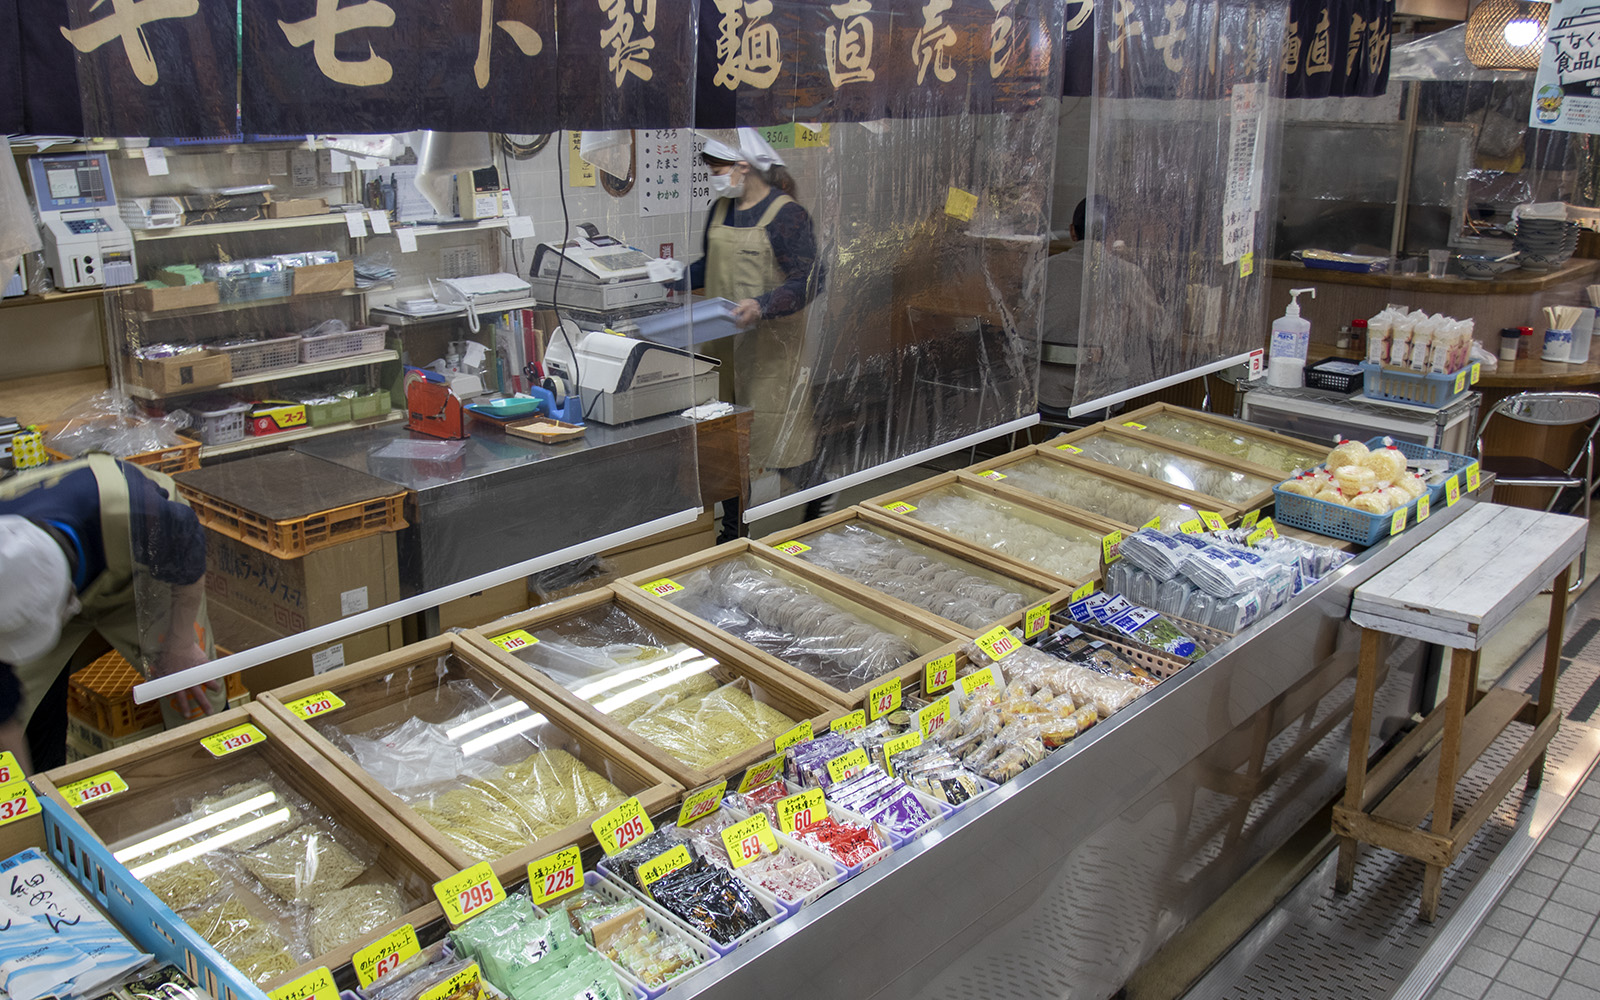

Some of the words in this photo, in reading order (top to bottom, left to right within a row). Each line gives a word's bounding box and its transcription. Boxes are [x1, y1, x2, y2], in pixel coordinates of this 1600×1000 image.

[505, 637, 526, 649] 115
[993, 638, 1012, 655] 610
[933, 669, 948, 686] 43
[304, 700, 332, 716] 120
[878, 694, 893, 712] 43
[224, 733, 252, 750] 130
[80, 782, 113, 800] 130
[794, 809, 811, 831] 60
[615, 815, 644, 849] 295
[741, 835, 760, 859] 59
[545, 866, 574, 896] 225
[460, 881, 493, 914] 295
